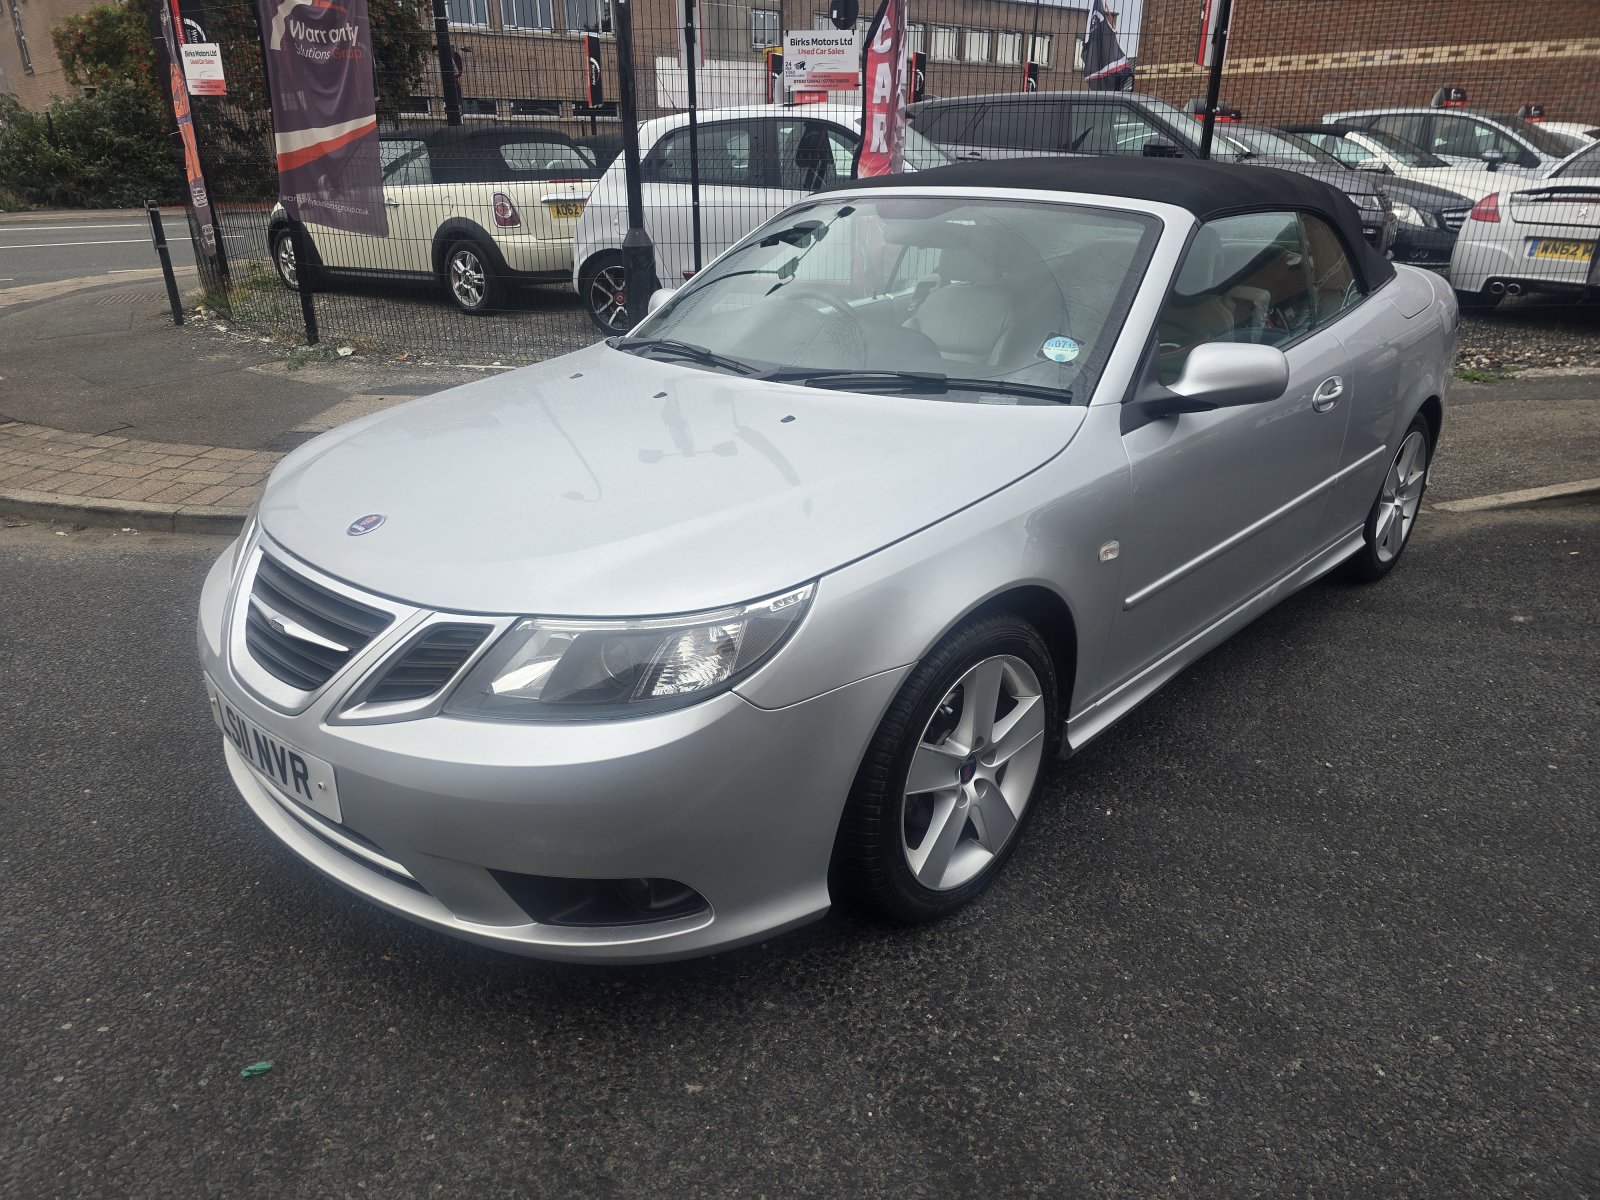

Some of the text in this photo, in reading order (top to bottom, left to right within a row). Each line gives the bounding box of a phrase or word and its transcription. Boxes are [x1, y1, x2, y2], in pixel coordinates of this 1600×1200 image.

[289, 19, 359, 47] Warranty
[790, 38, 853, 46] Birks Motors Ltd
[870, 15, 892, 153] CAR
[215, 693, 314, 801] LS11 NVR
